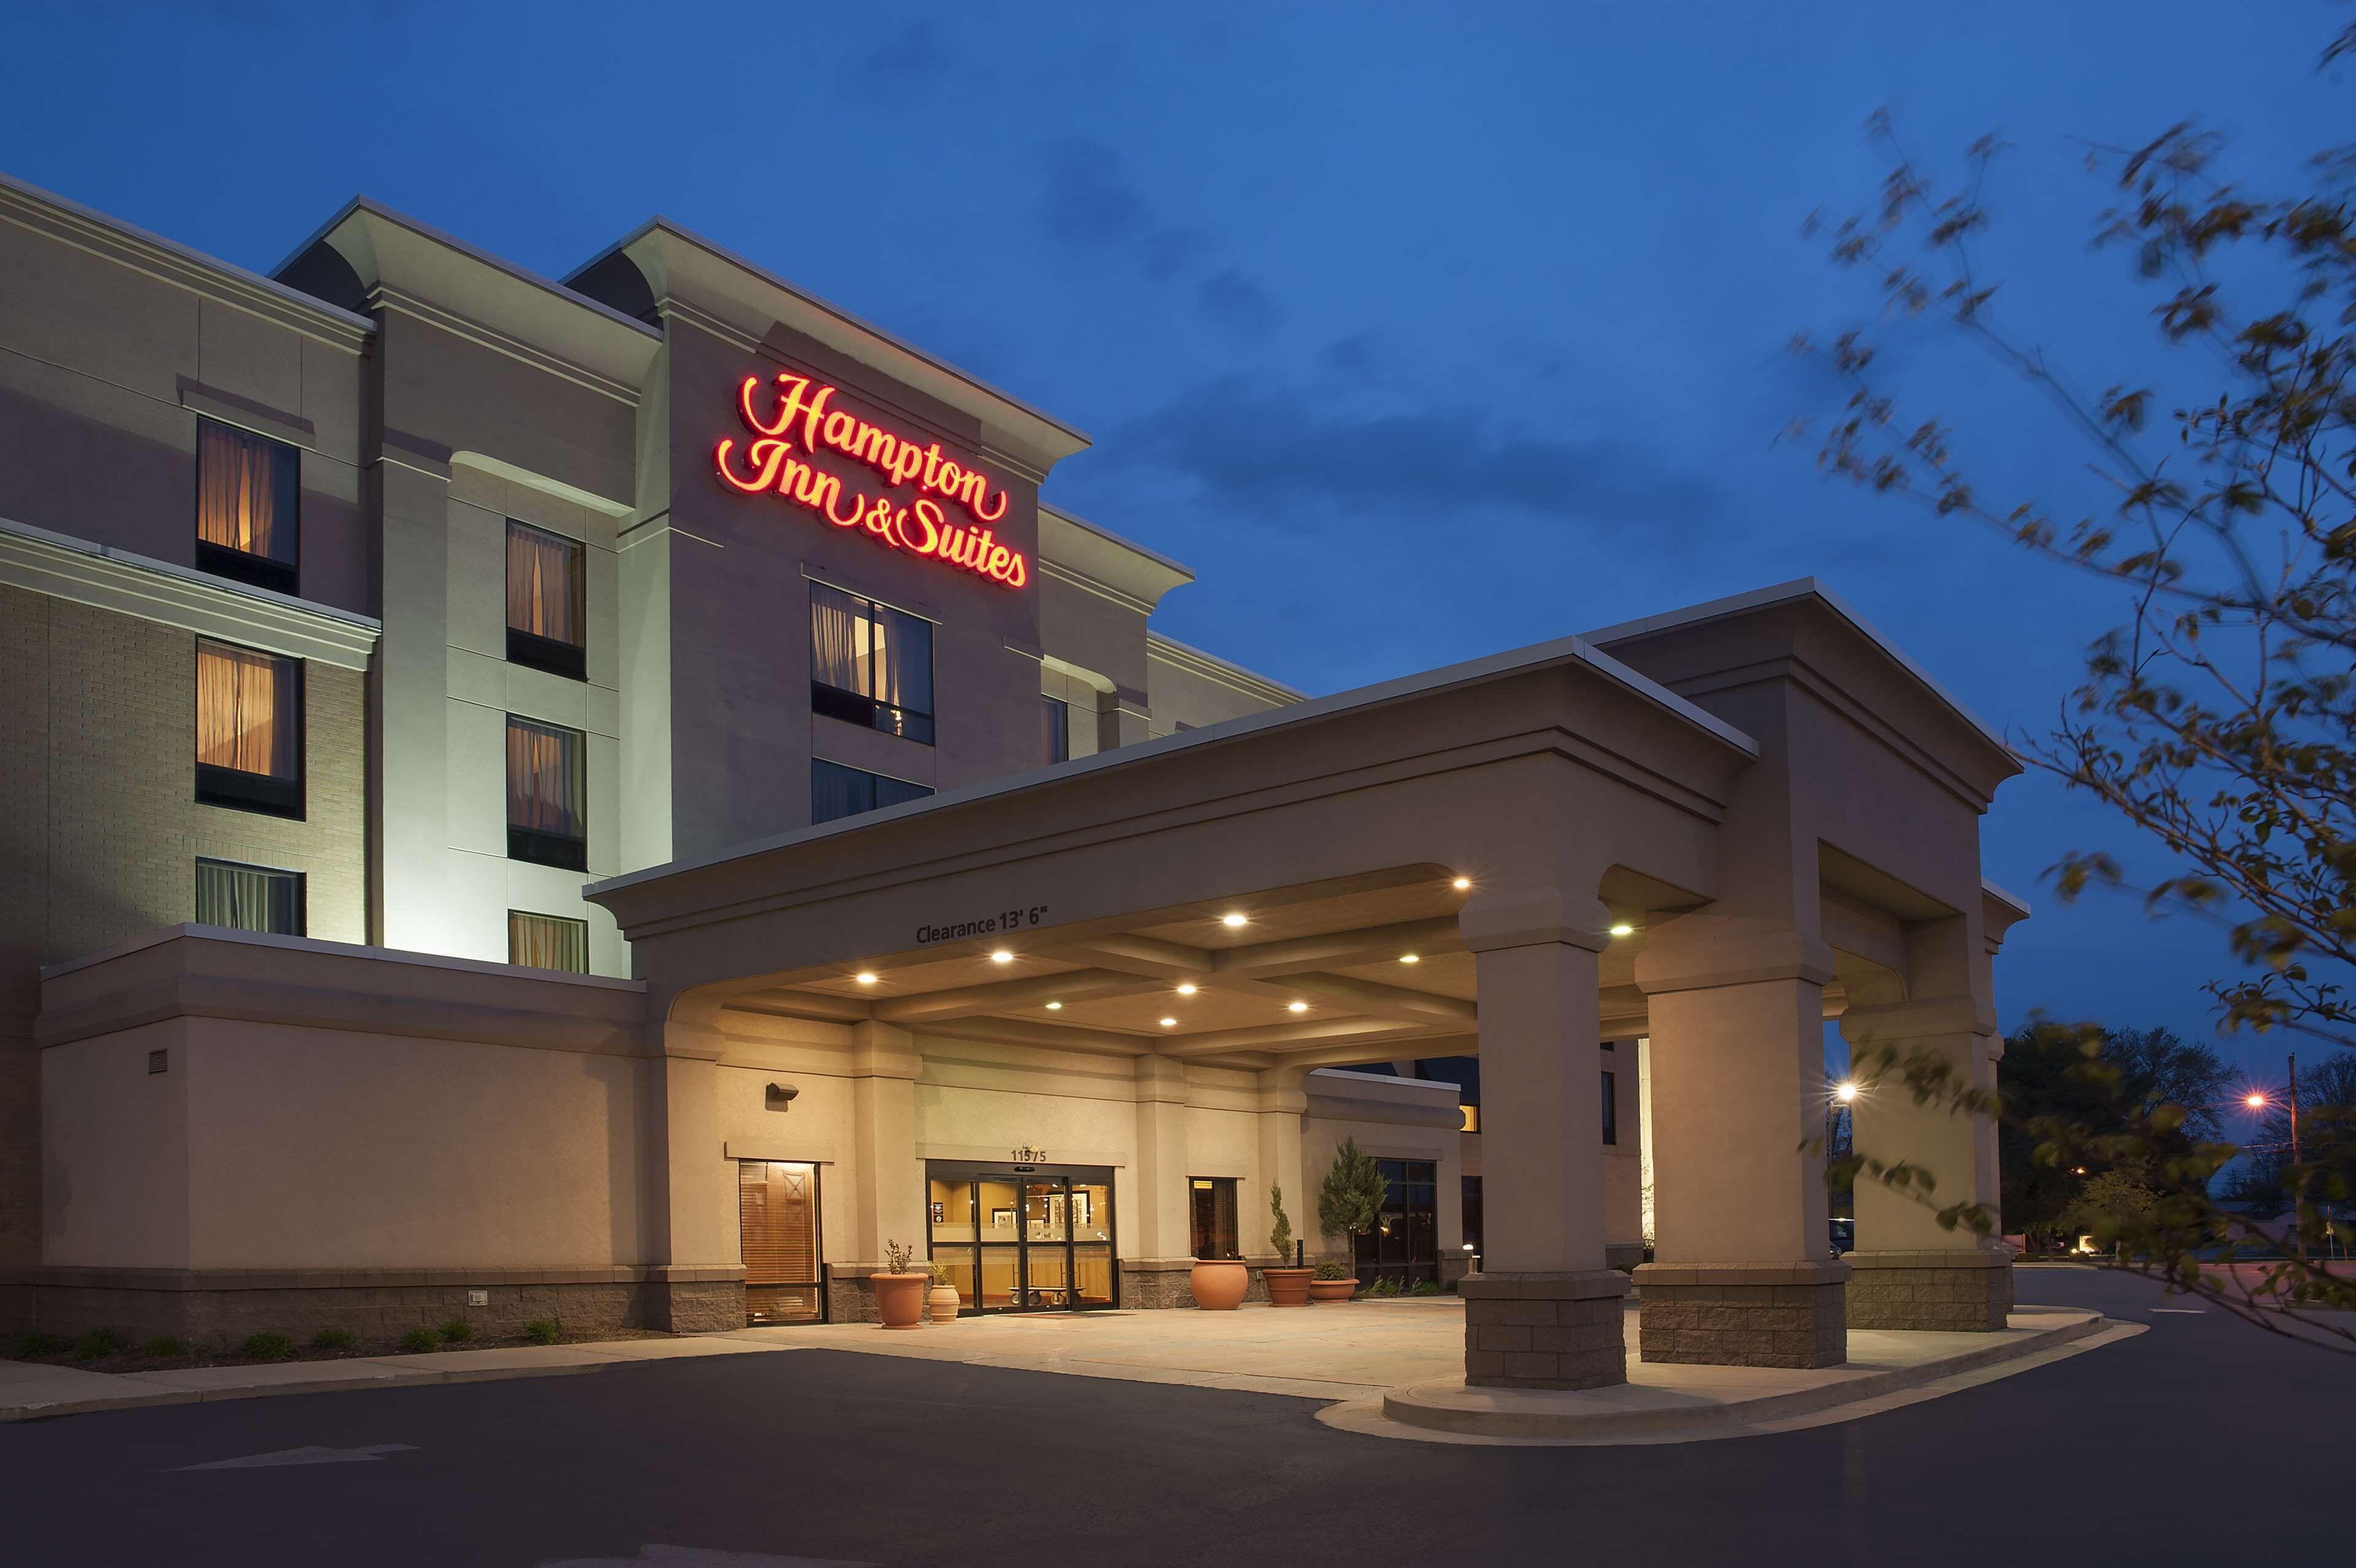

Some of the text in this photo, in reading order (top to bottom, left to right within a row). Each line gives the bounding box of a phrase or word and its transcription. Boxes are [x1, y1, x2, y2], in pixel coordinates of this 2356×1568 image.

[716, 438, 1027, 589] Inn & Suites
[738, 373, 1008, 521] Hampton
[916, 905, 1048, 943] Clearance 13' 6"
